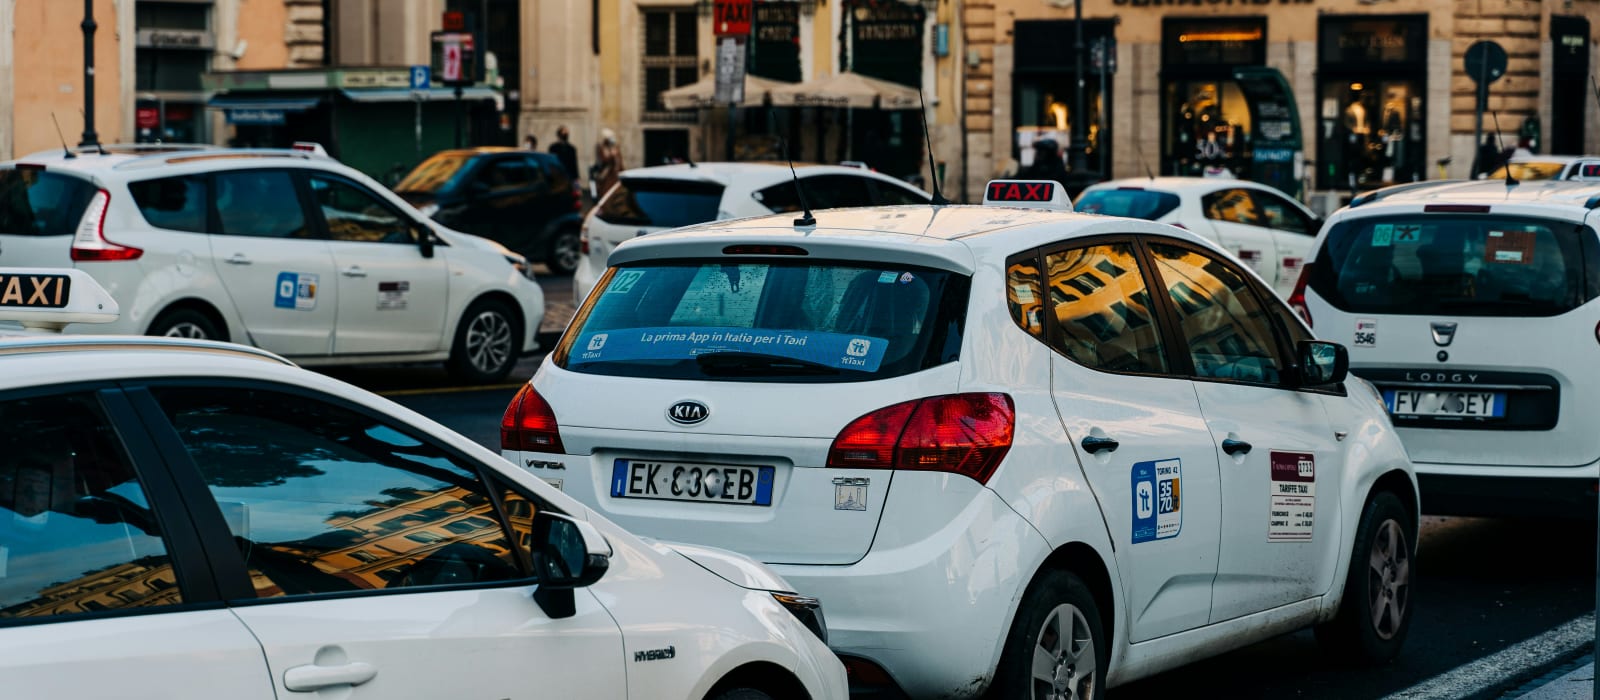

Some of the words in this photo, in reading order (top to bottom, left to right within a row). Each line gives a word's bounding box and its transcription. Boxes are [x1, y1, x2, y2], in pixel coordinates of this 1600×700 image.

[716, 3, 751, 23] TAXI
[415, 69, 426, 87] P
[1586, 164, 1600, 176] T
[990, 183, 1051, 201] TAXI
[612, 270, 639, 292] 02
[641, 333, 651, 342] La
[653, 333, 685, 344] prima
[687, 332, 709, 344] App
[711, 333, 722, 341] in
[724, 333, 752, 343] Italia
[753, 335, 775, 346] per
[784, 335, 808, 346] Taxi
[1354, 332, 1376, 345] 3546
[1406, 372, 1478, 382] LODGY
[674, 405, 701, 418] KIA
[525, 459, 566, 470] VENGA
[629, 463, 662, 495] EK
[1160, 481, 1172, 498] 35
[1279, 484, 1297, 493] TARIFFE
[1298, 484, 1308, 493] TAXI
[634, 646, 675, 662] HYBRID
